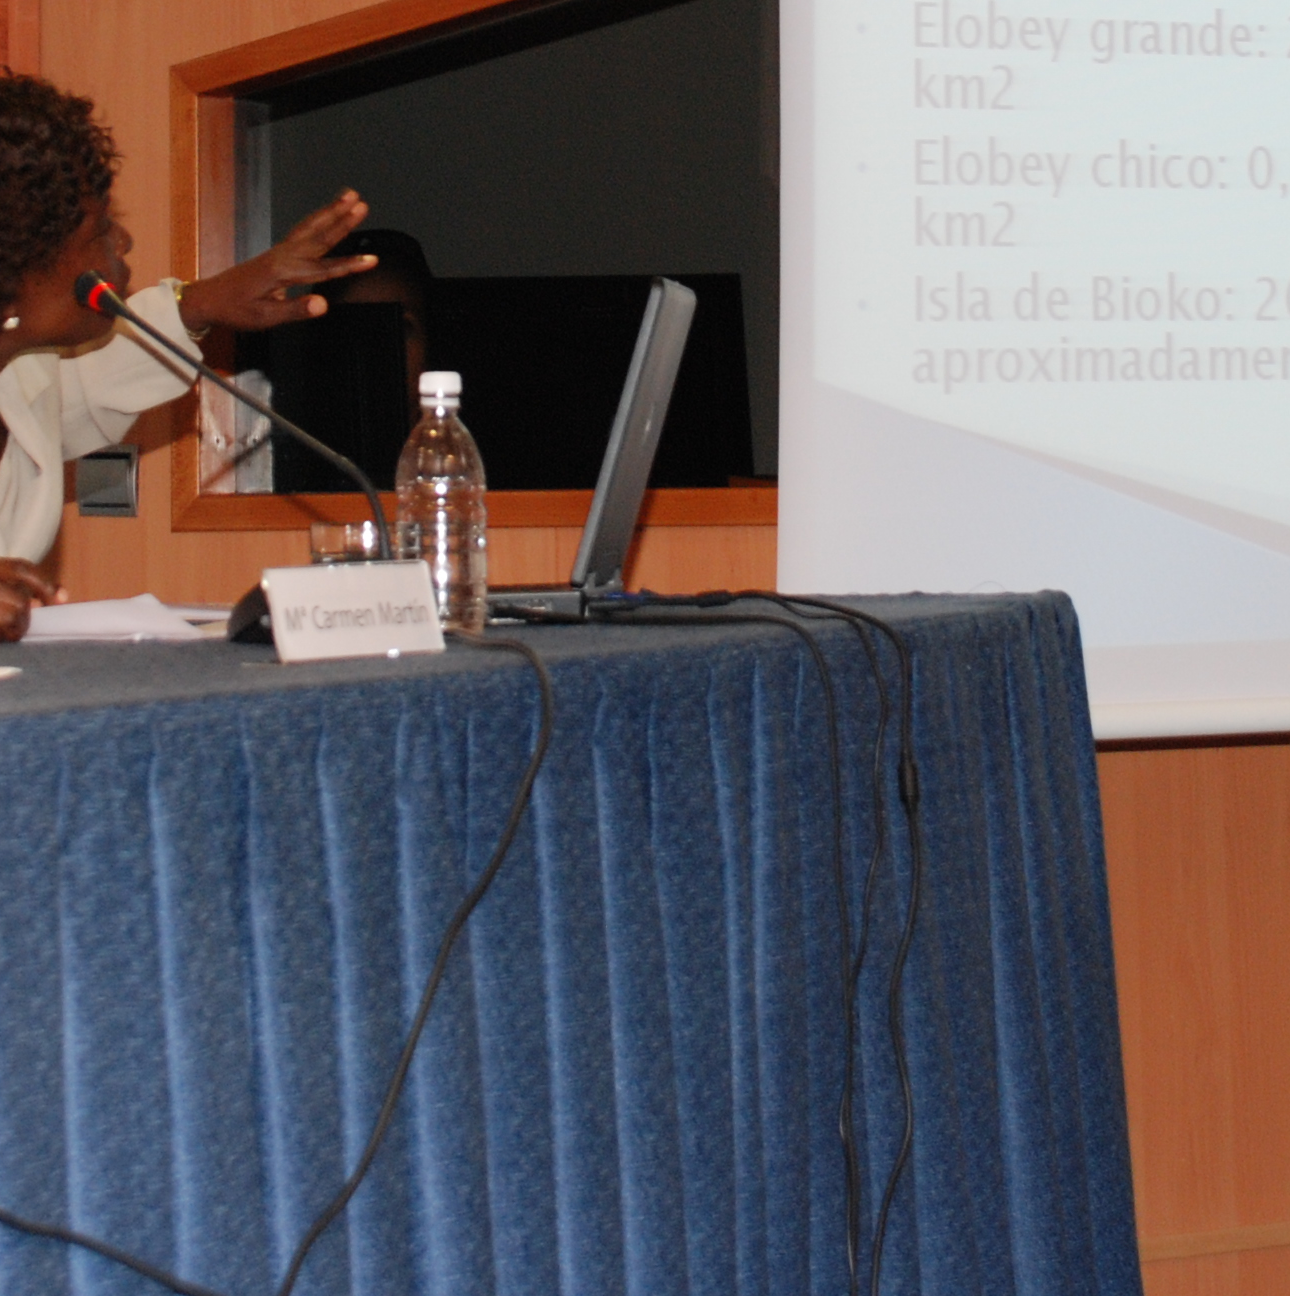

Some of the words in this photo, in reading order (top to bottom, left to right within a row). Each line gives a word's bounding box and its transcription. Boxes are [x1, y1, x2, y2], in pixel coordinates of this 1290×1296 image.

[913, 0, 1071, 62] Elobey
[1089, 8, 1268, 64] grande:
[913, 58, 1016, 110] km2
[913, 136, 1072, 198] Elobey
[1090, 138, 1229, 190] chico:
[913, 197, 1016, 248] km2
[913, 272, 992, 323] Isla
[1013, 271, 1071, 322] de
[1091, 271, 1235, 322] Bioko:
[312, 604, 376, 630] Carmen
